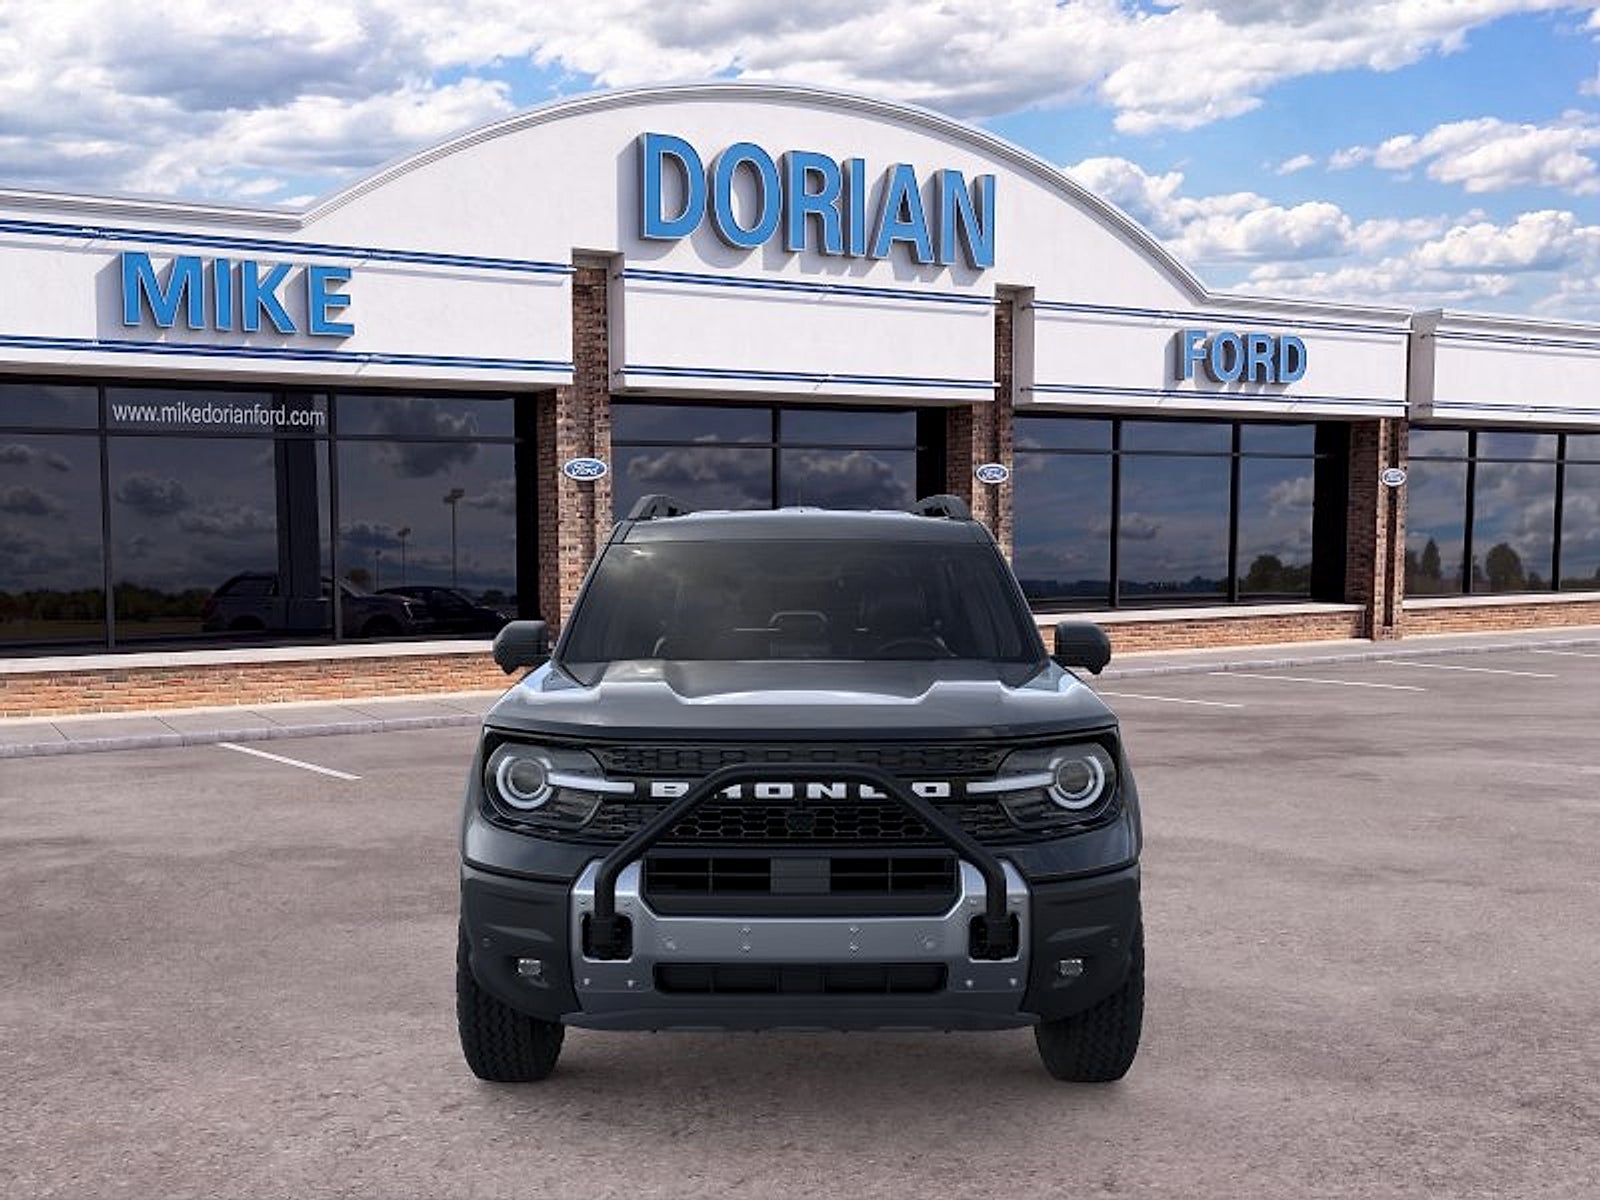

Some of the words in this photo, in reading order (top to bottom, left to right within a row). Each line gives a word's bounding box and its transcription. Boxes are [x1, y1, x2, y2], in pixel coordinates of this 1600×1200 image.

[638, 131, 996, 270] DORIAN
[121, 250, 355, 337] MIKE
[1182, 328, 1307, 384] FORD
[112, 402, 326, 427] www.mikedorianford.com
